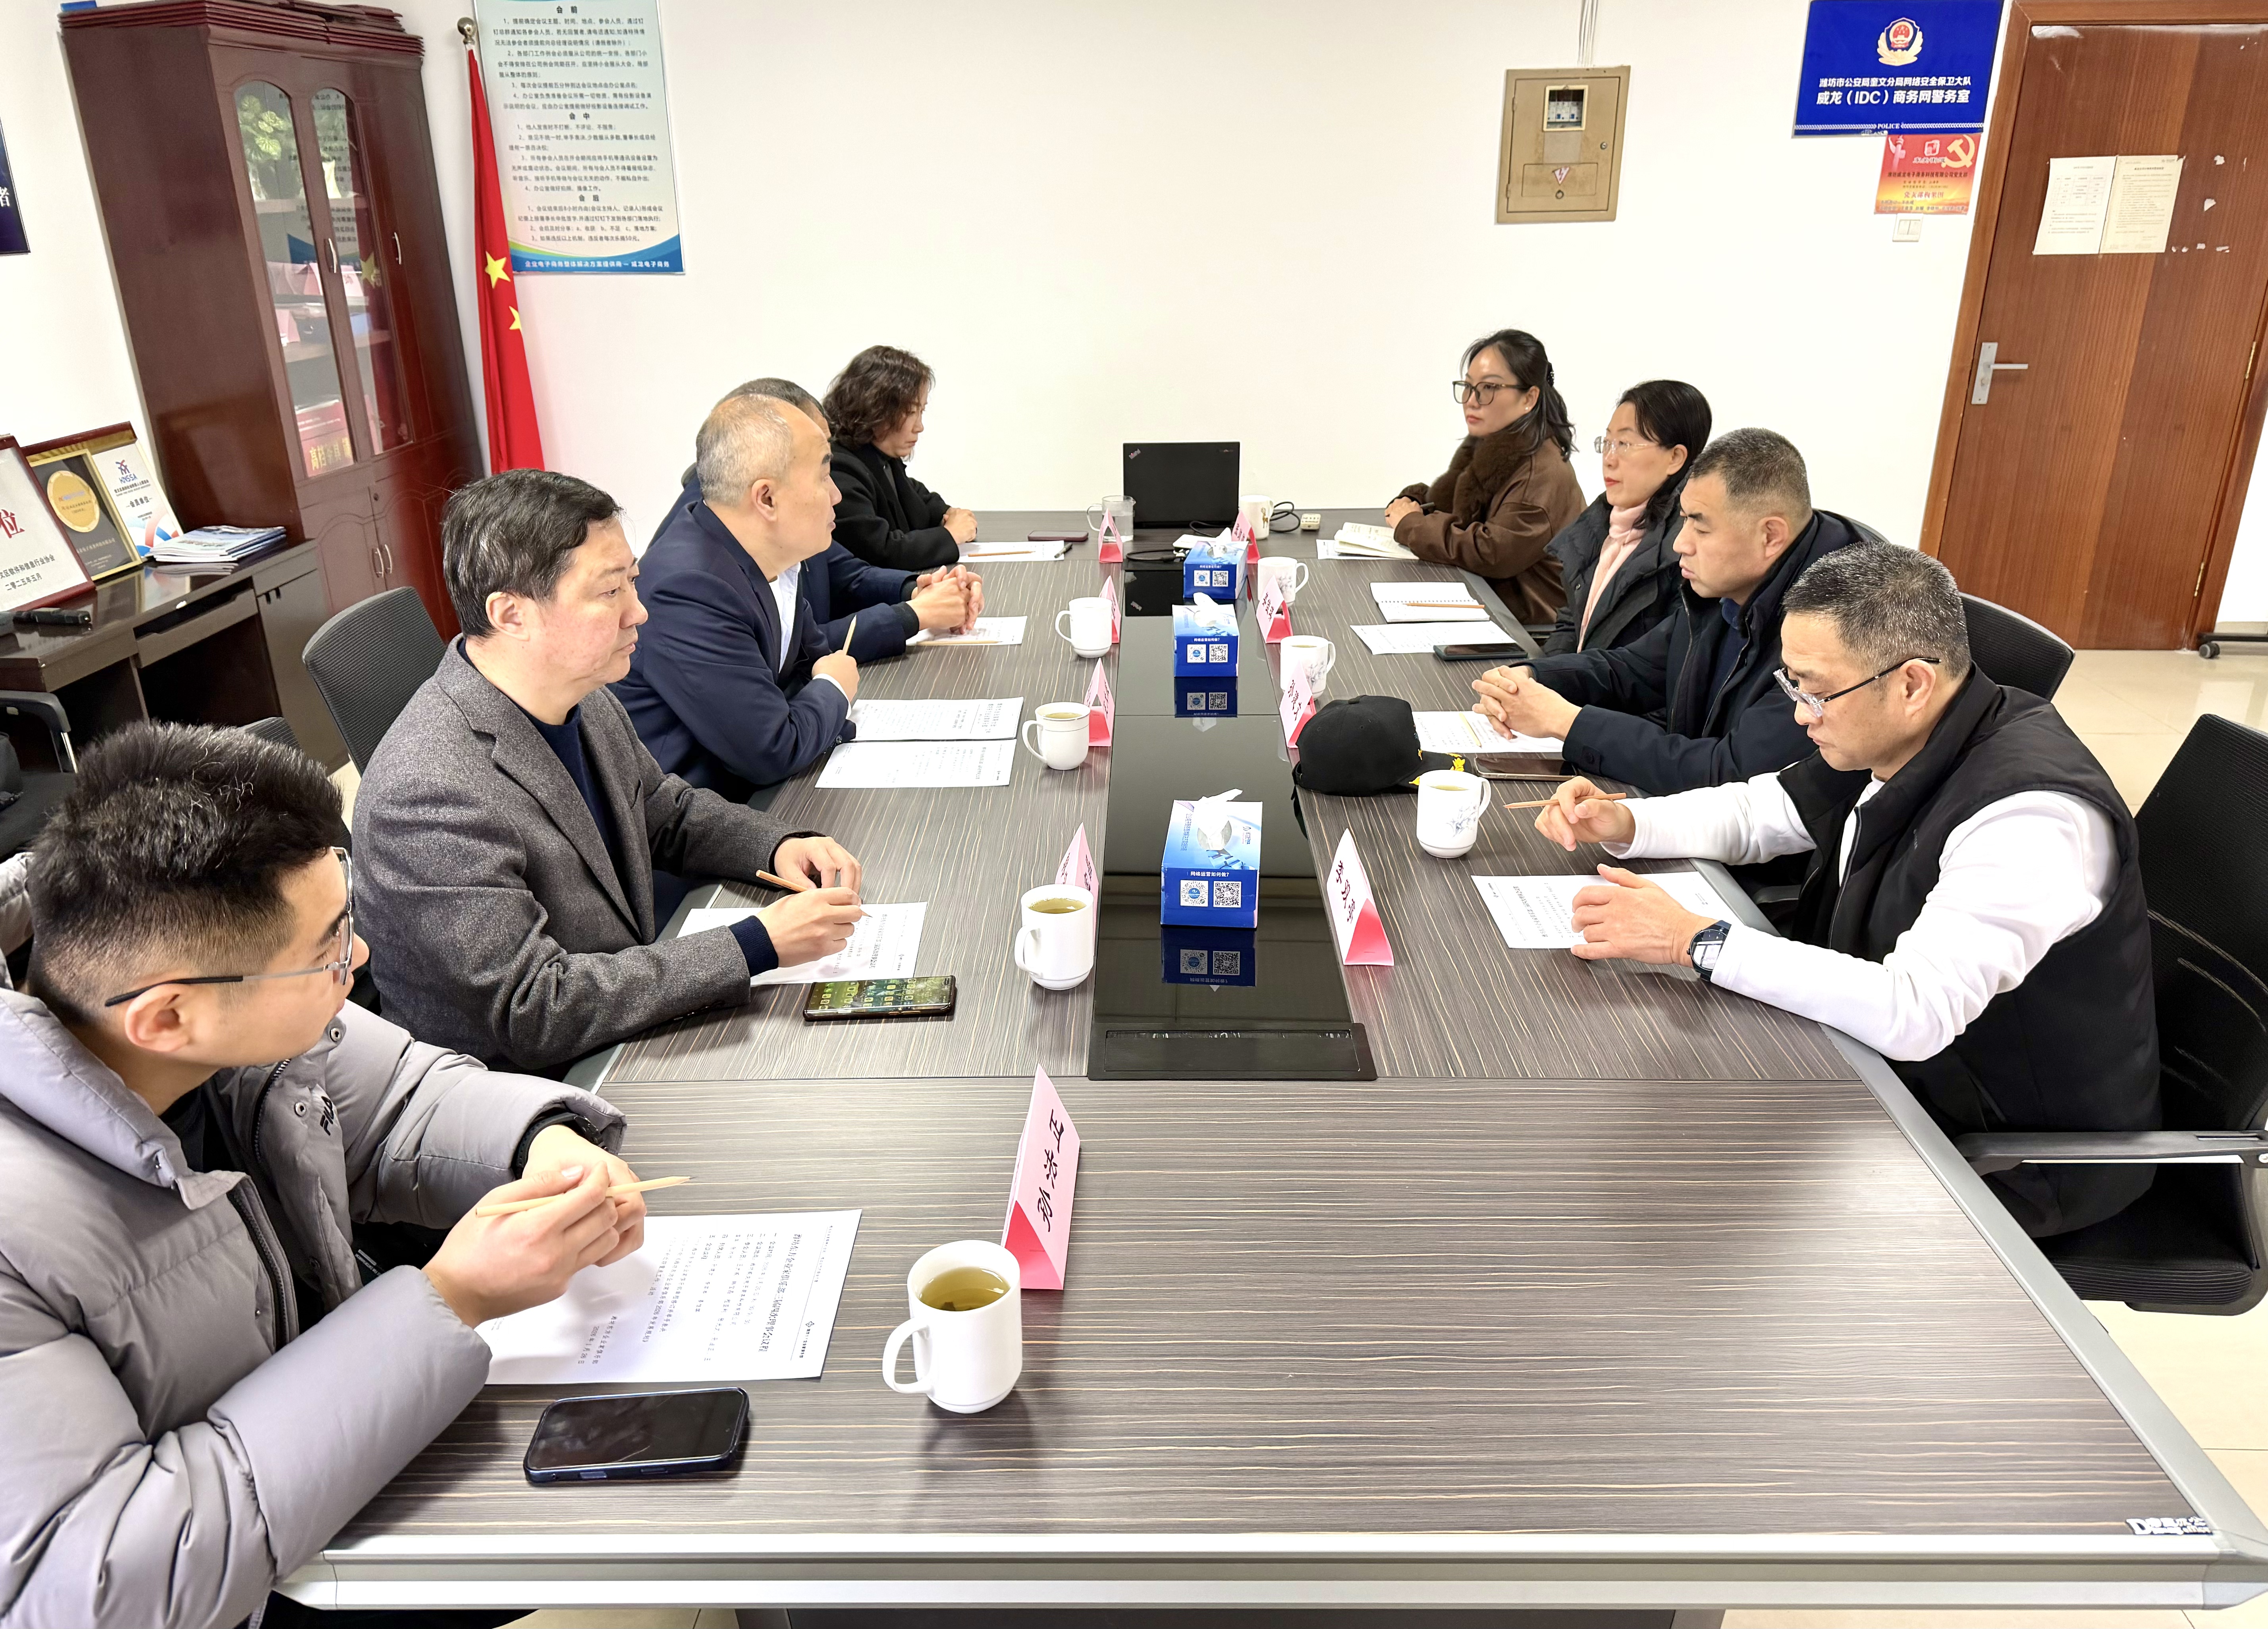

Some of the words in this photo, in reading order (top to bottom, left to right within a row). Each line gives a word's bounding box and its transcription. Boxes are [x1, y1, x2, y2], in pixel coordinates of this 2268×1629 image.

[1819, 76, 1971, 87] 潍坊市公安局奎文分局网络安全保卫大队
[0, 509, 25, 539] 位
[5, 573, 42, 591] 二零二五年五月
